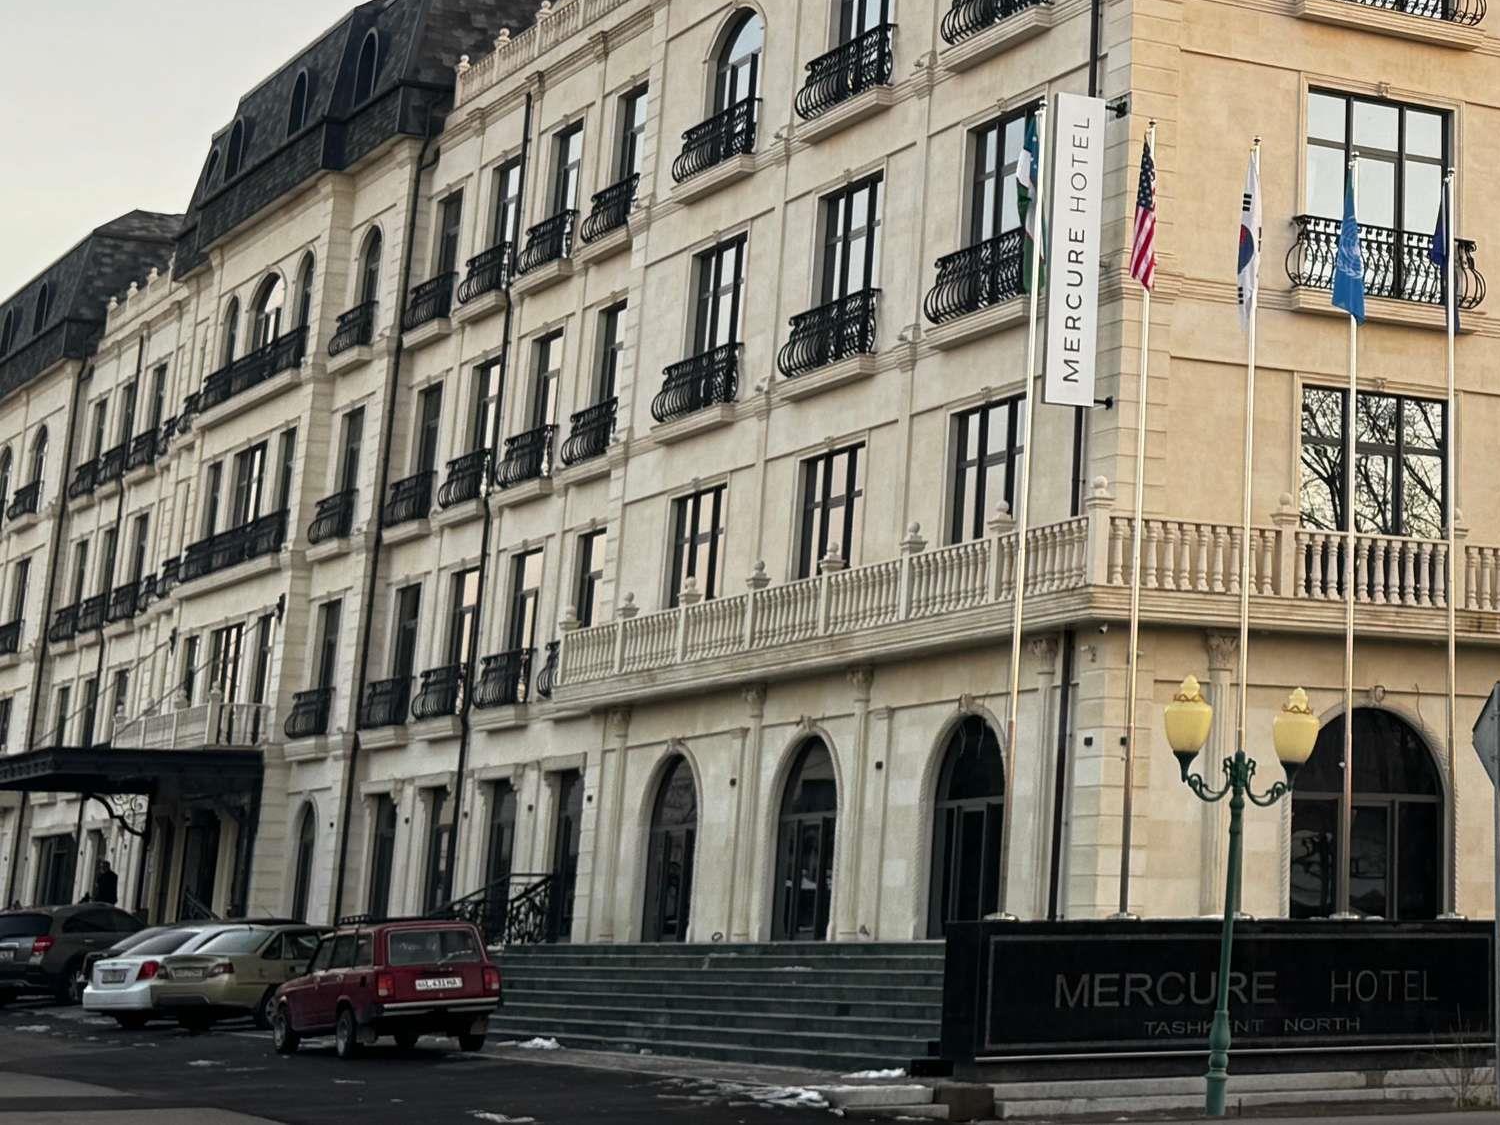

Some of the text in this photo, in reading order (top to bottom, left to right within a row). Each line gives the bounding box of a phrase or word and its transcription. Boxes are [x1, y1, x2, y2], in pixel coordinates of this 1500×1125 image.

[1063, 118, 1090, 383] MERCURE HOTEL
[1055, 970, 1438, 1008] MERCURE HOTEL
[1144, 1017, 1360, 1035] TASHKNT NORTH
